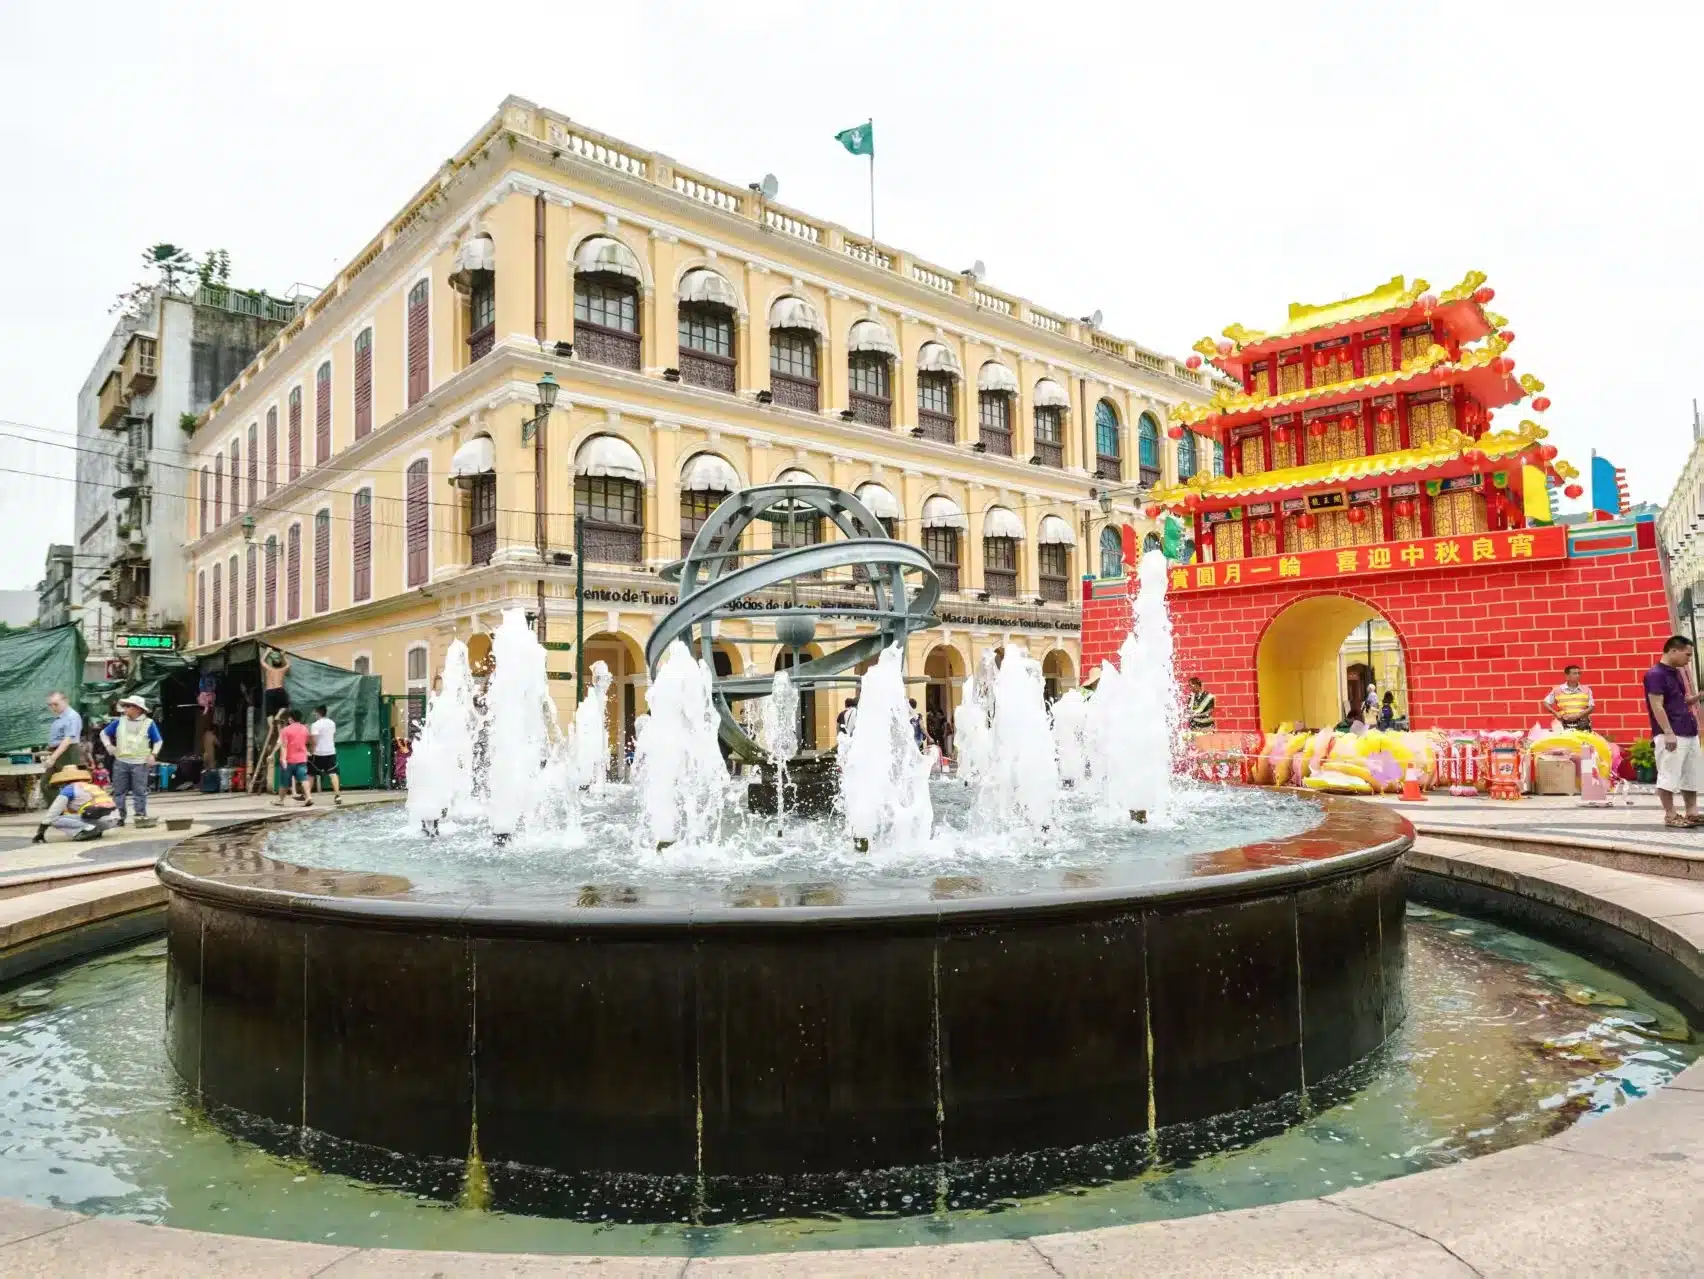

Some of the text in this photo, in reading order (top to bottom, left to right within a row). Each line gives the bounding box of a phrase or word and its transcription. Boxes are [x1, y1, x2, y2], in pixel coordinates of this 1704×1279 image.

[1335, 533, 1535, 573] 喜迎中秋良宵
[621, 589, 638, 602] de
[641, 591, 680, 606] Turis
[942, 612, 1081, 631] Macau Business Tourism Centre
